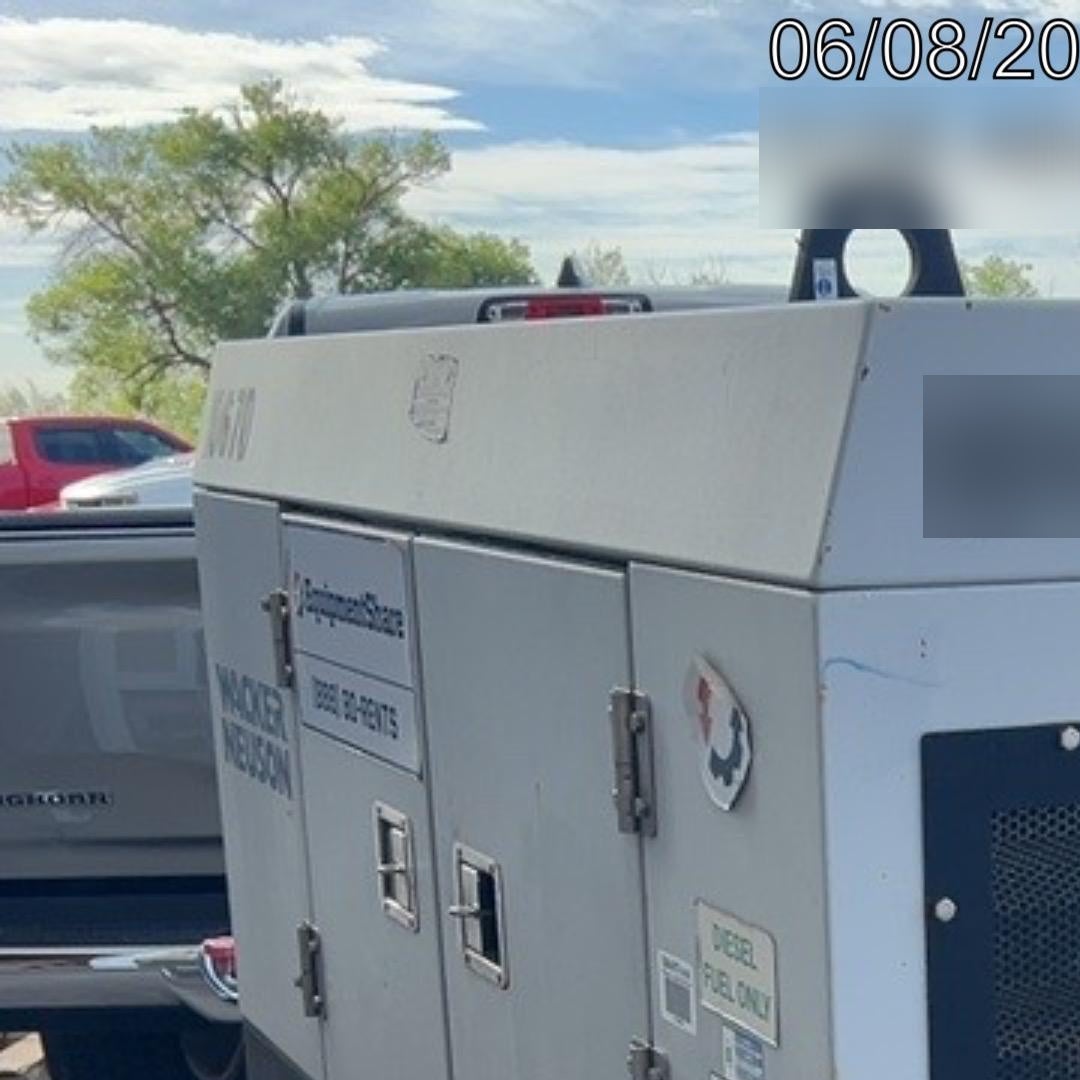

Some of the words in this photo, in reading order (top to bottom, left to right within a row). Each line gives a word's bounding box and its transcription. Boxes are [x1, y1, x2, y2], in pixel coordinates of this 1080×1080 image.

[215, 663, 288, 742] WACKER
[221, 718, 292, 801] NEUSON
[712, 923, 757, 970] DIESEL
[703, 961, 736, 1003] FUEL
